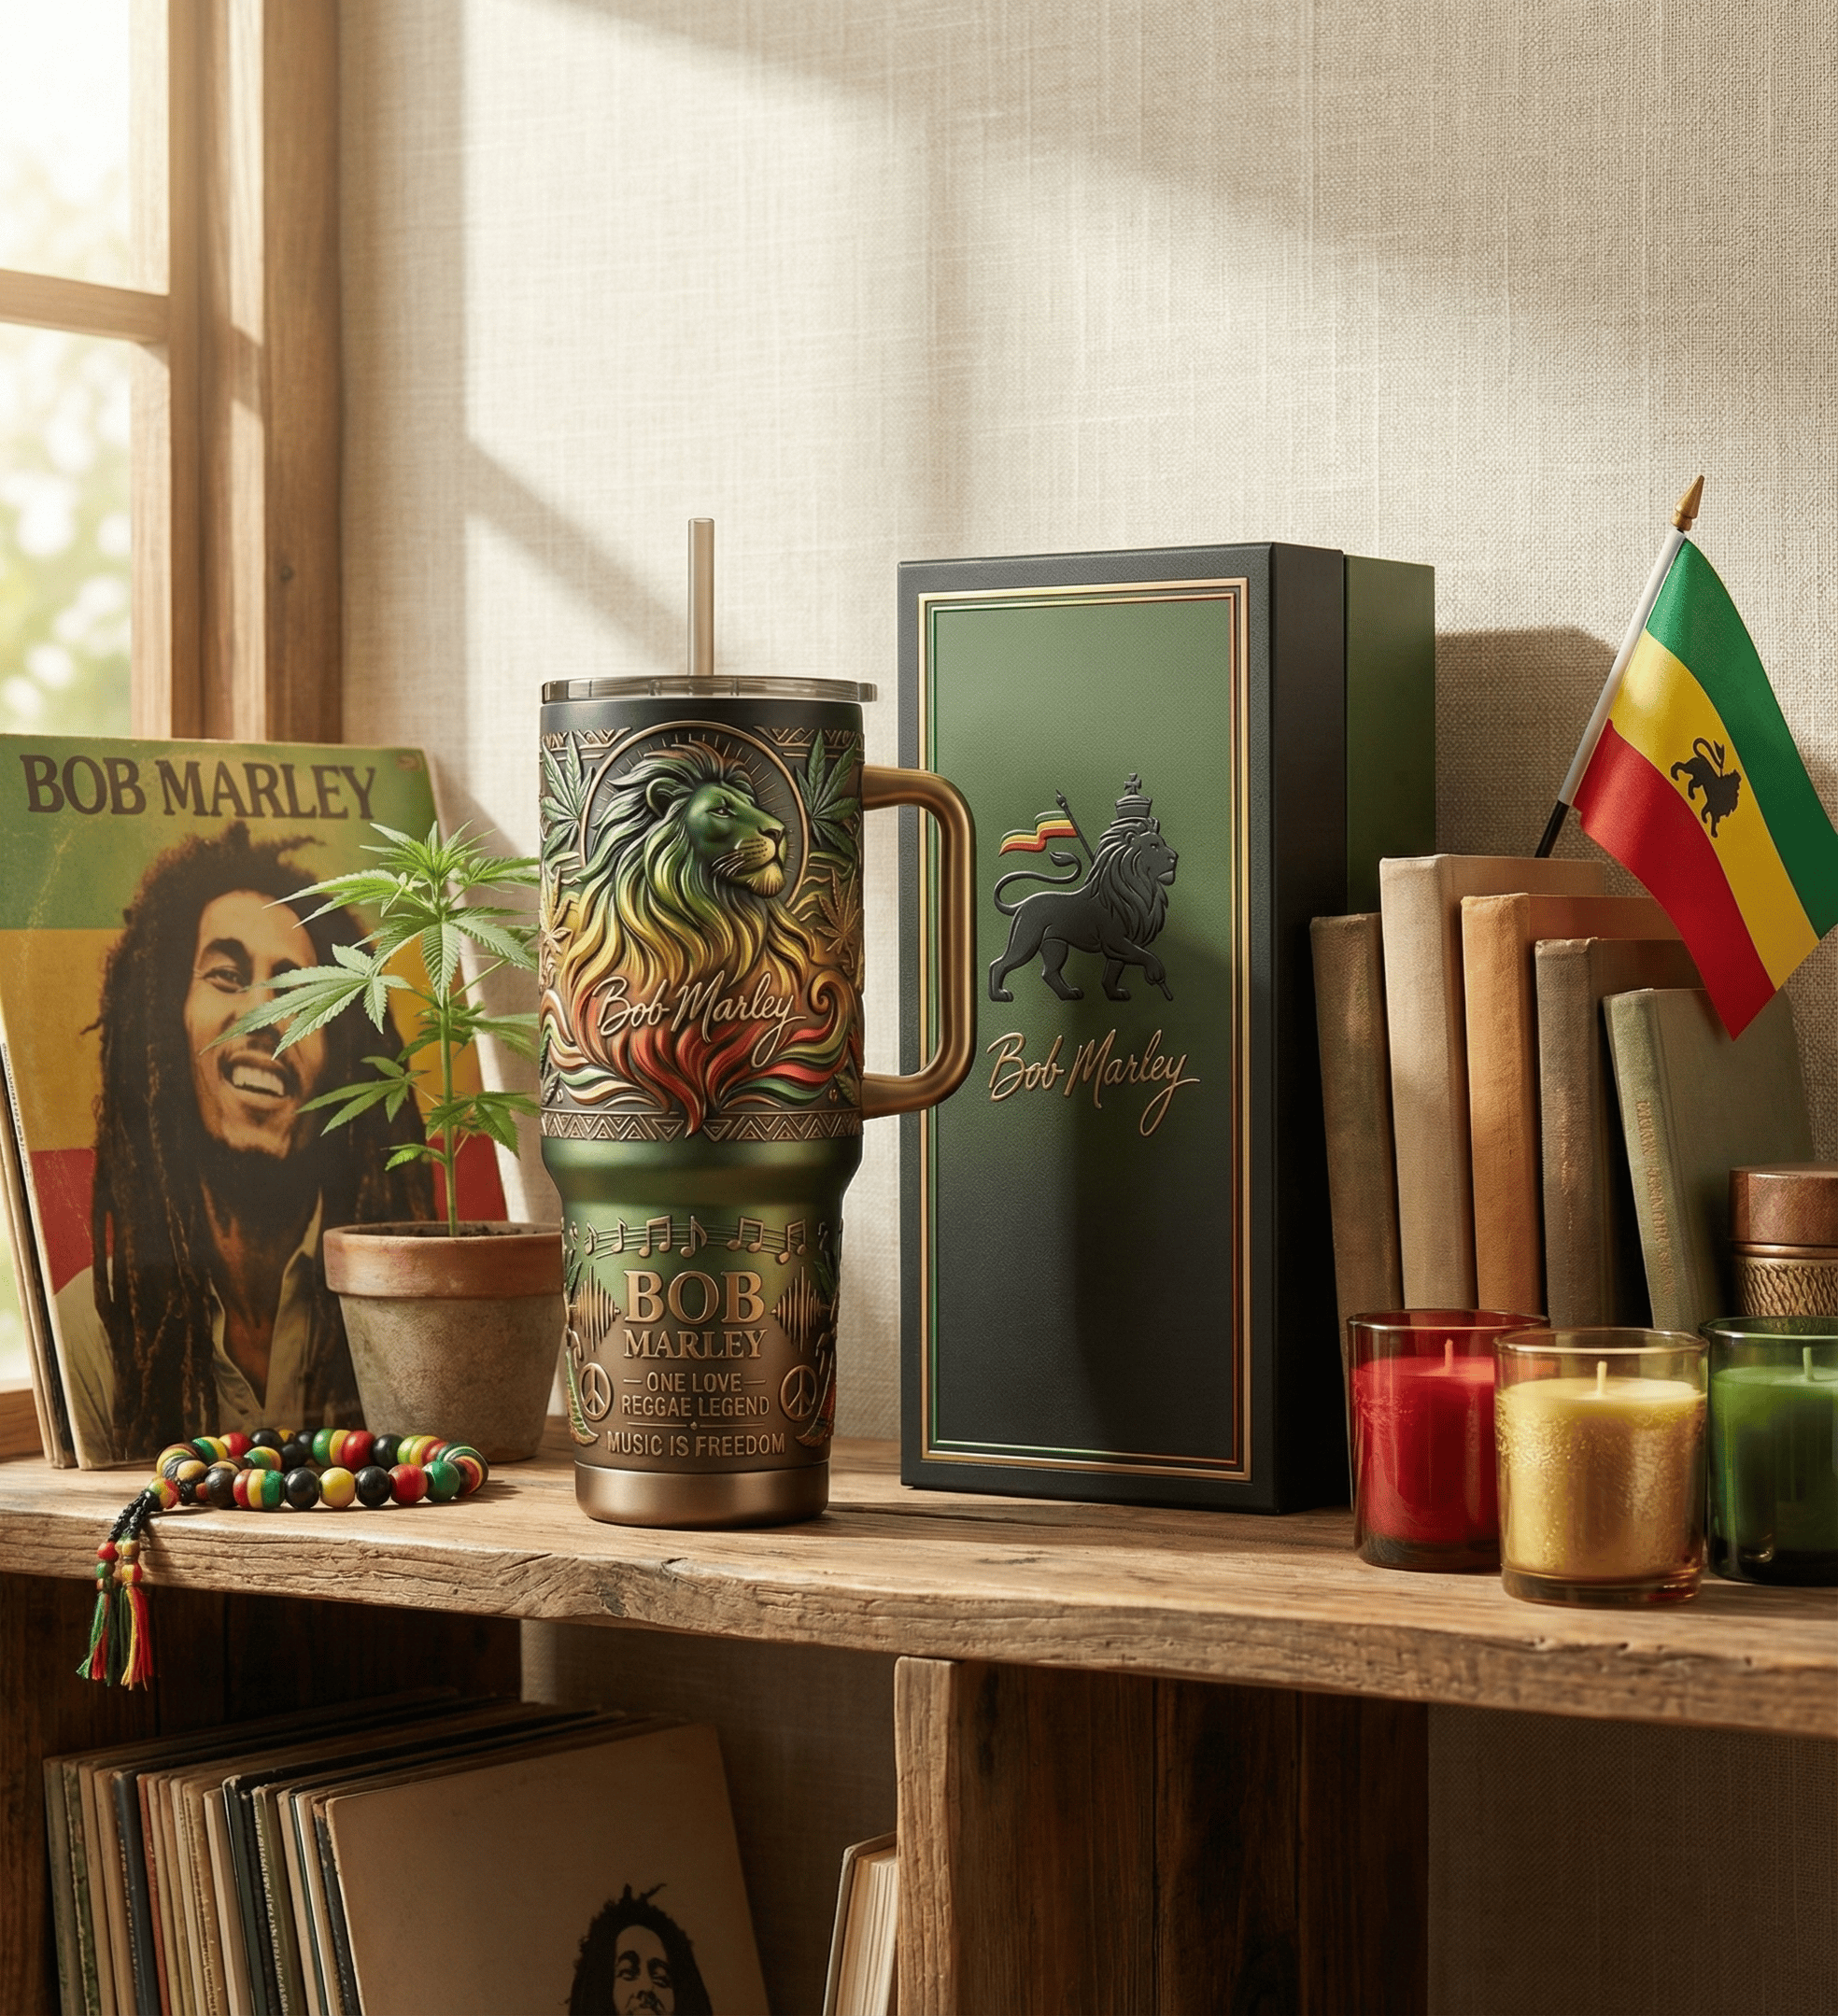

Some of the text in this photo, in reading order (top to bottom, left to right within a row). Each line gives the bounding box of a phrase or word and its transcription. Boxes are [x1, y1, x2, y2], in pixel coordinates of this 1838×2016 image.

[19, 754, 375, 820] BOB MARLEY
[591, 969, 807, 1068] Bob Marley
[986, 1028, 1201, 1136] Bob Marley
[623, 1270, 766, 1324] BOB
[622, 1328, 768, 1360] MARLEY
[646, 1371, 742, 1392] ONE LOVE
[621, 1394, 770, 1417] REGGAE LEGEND
[607, 1430, 785, 1458] MUSIC IS FREEDOM
